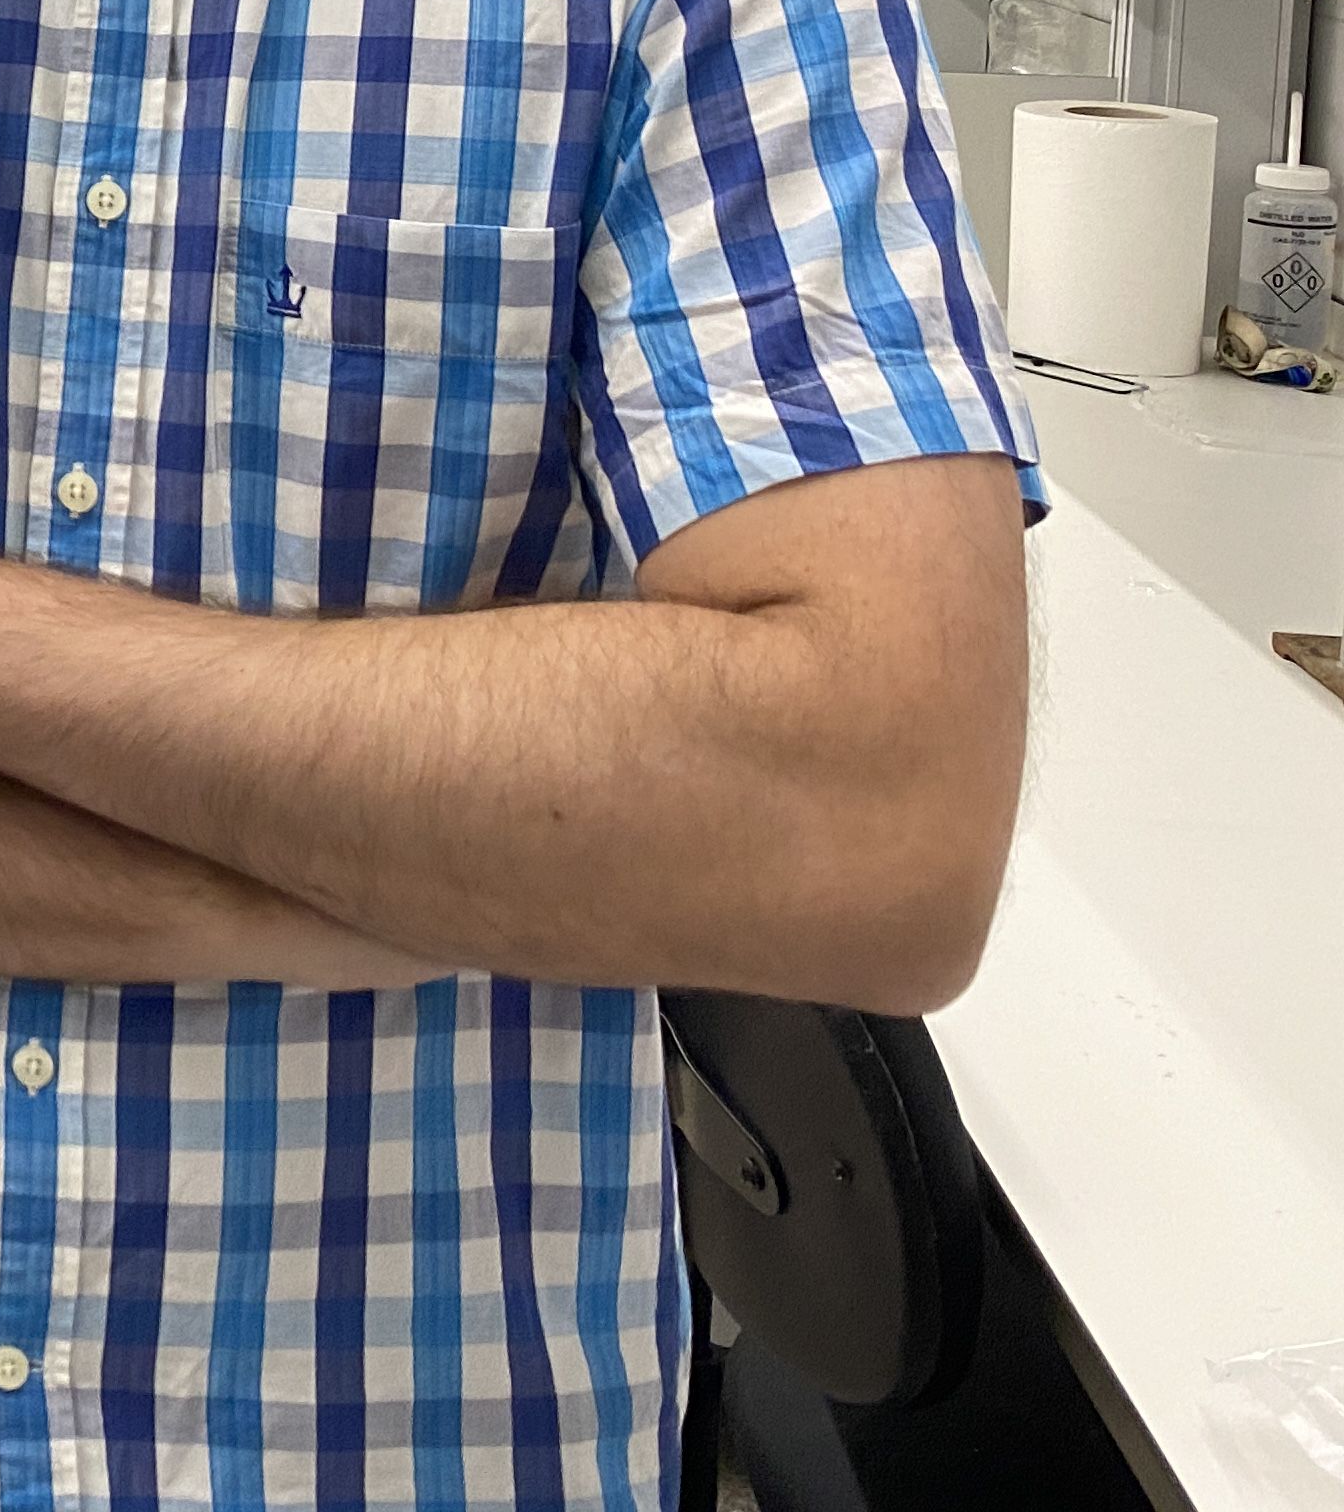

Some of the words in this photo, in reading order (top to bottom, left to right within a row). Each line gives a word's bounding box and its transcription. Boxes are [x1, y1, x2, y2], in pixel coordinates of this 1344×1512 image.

[1291, 260, 1303, 275] 0
[1272, 273, 1284, 288] 0
[1307, 275, 1317, 290] 0
